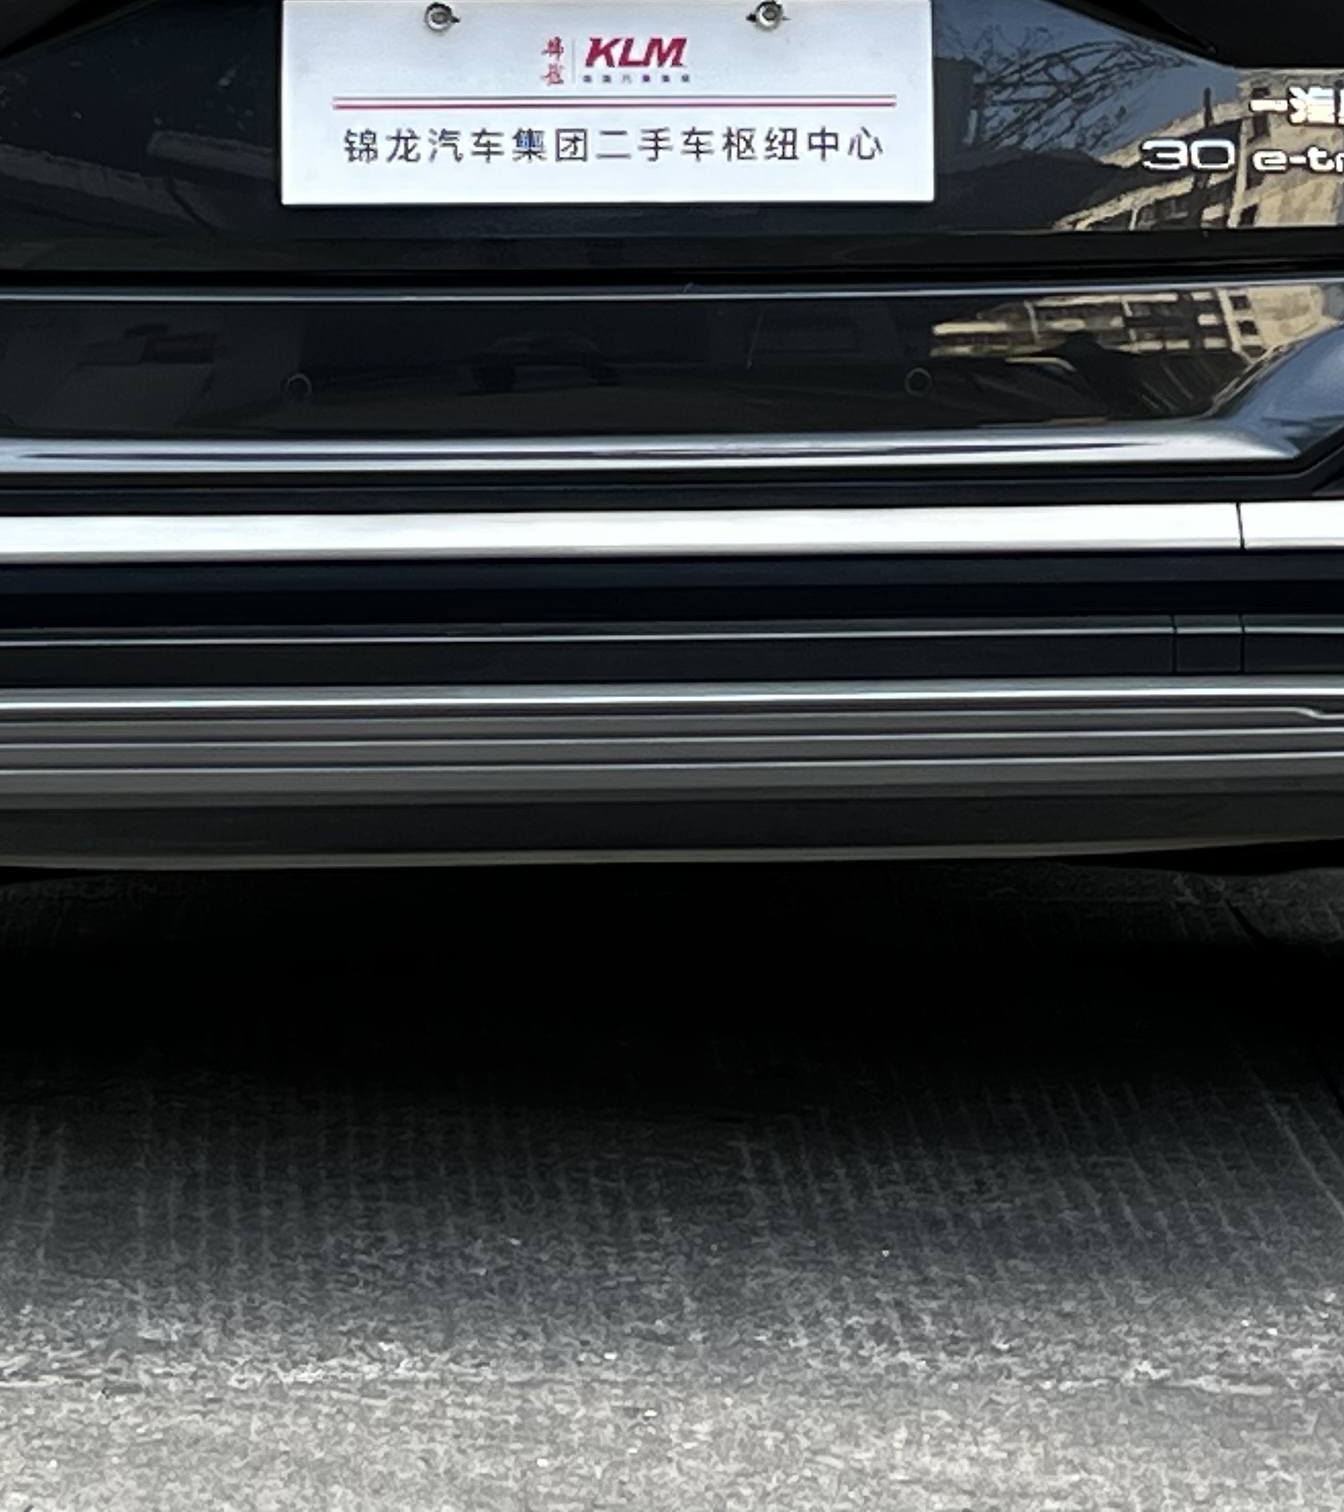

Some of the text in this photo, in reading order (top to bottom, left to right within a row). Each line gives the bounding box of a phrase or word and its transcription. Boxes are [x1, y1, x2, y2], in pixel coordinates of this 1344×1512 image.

[584, 36, 690, 68] KLM
[343, 127, 884, 164] 锦龙汽车集团二手车枢纽中心
[1141, 139, 1236, 171] 30
